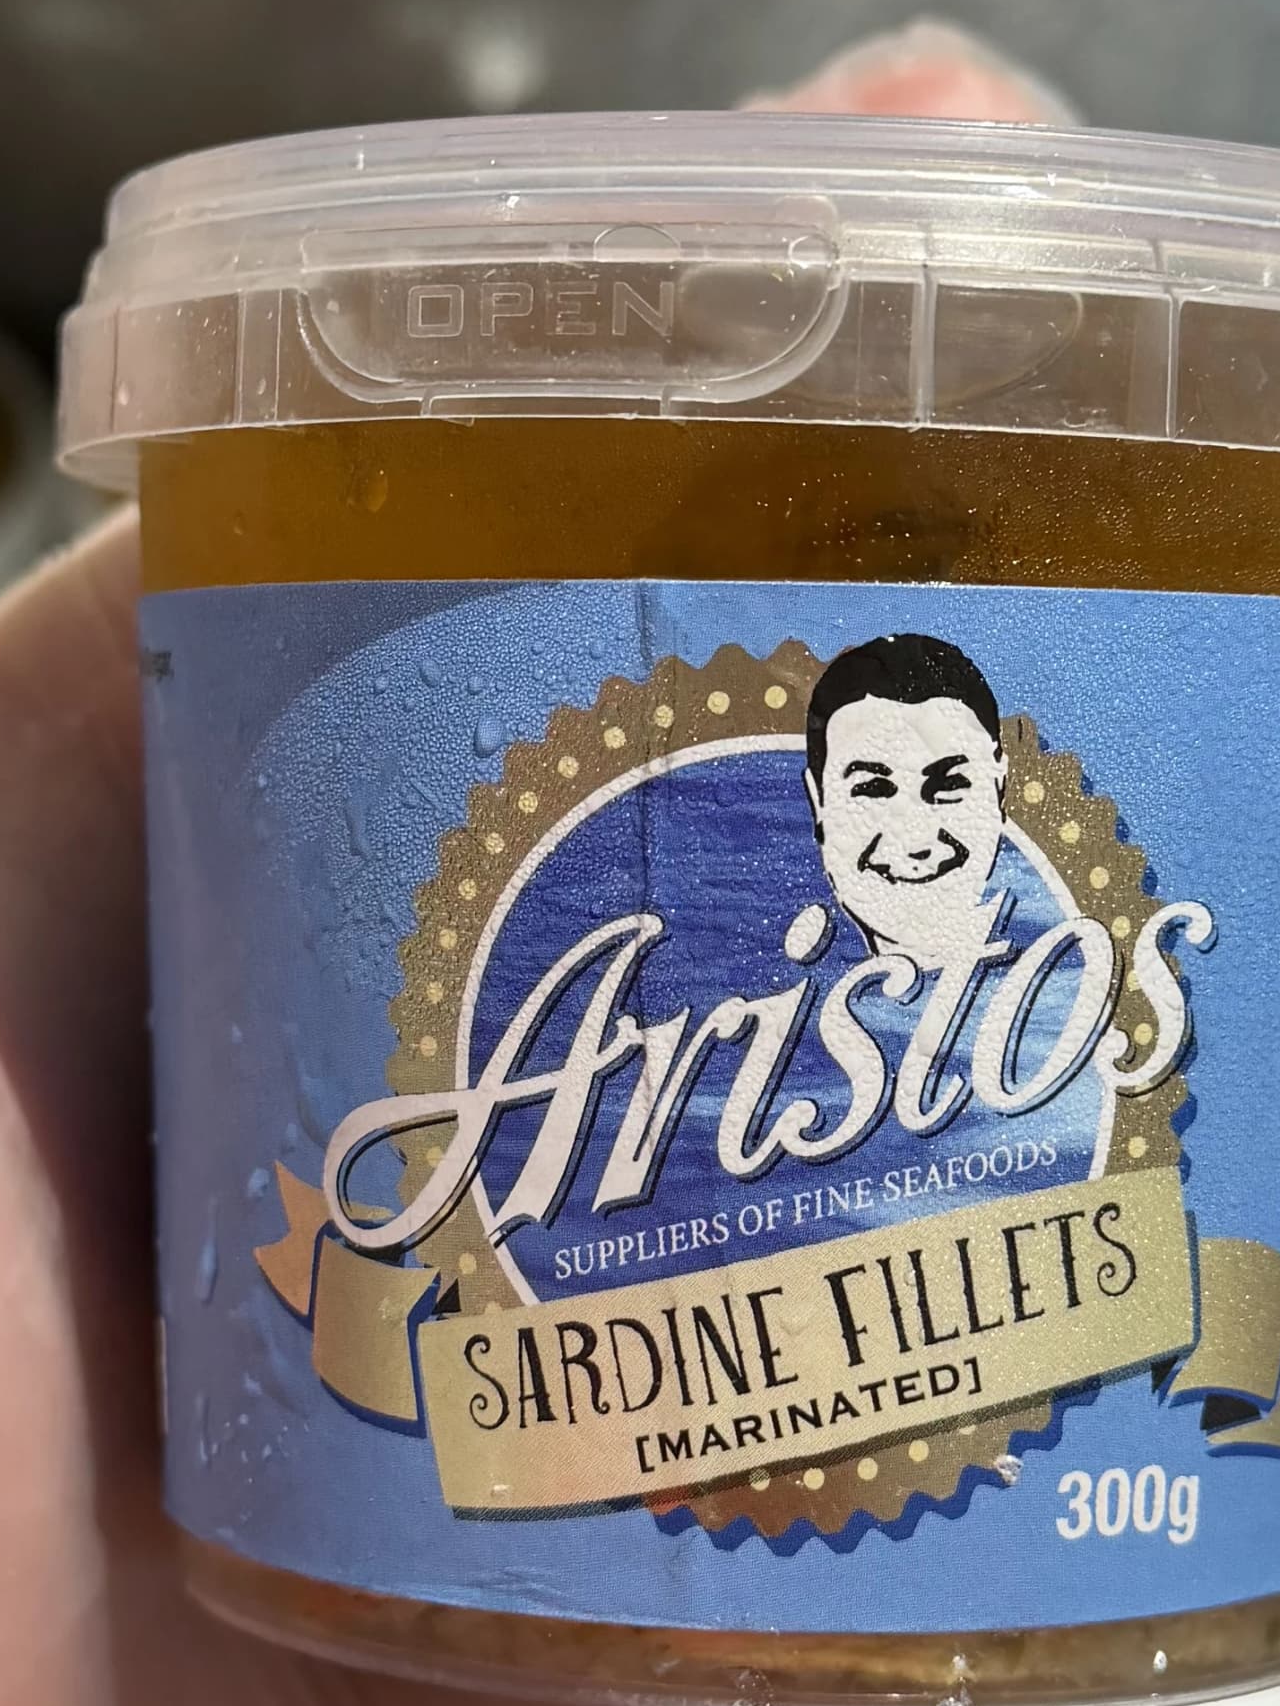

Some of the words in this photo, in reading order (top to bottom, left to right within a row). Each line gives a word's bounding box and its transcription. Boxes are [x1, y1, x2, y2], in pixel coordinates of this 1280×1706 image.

[406, 281, 677, 338] OPEN
[322, 887, 1218, 1249] Aristos
[553, 1212, 730, 1281] SUPPLIERS
[737, 1201, 785, 1237] OF
[791, 1178, 876, 1226] FINE
[876, 1139, 1058, 1204] SEAFOODS
[462, 1285, 800, 1431] SARDINE
[822, 1200, 1139, 1370] FILLETS
[634, 1355, 984, 1475] [MARINATED]
[1055, 1464, 1201, 1544] 300g
